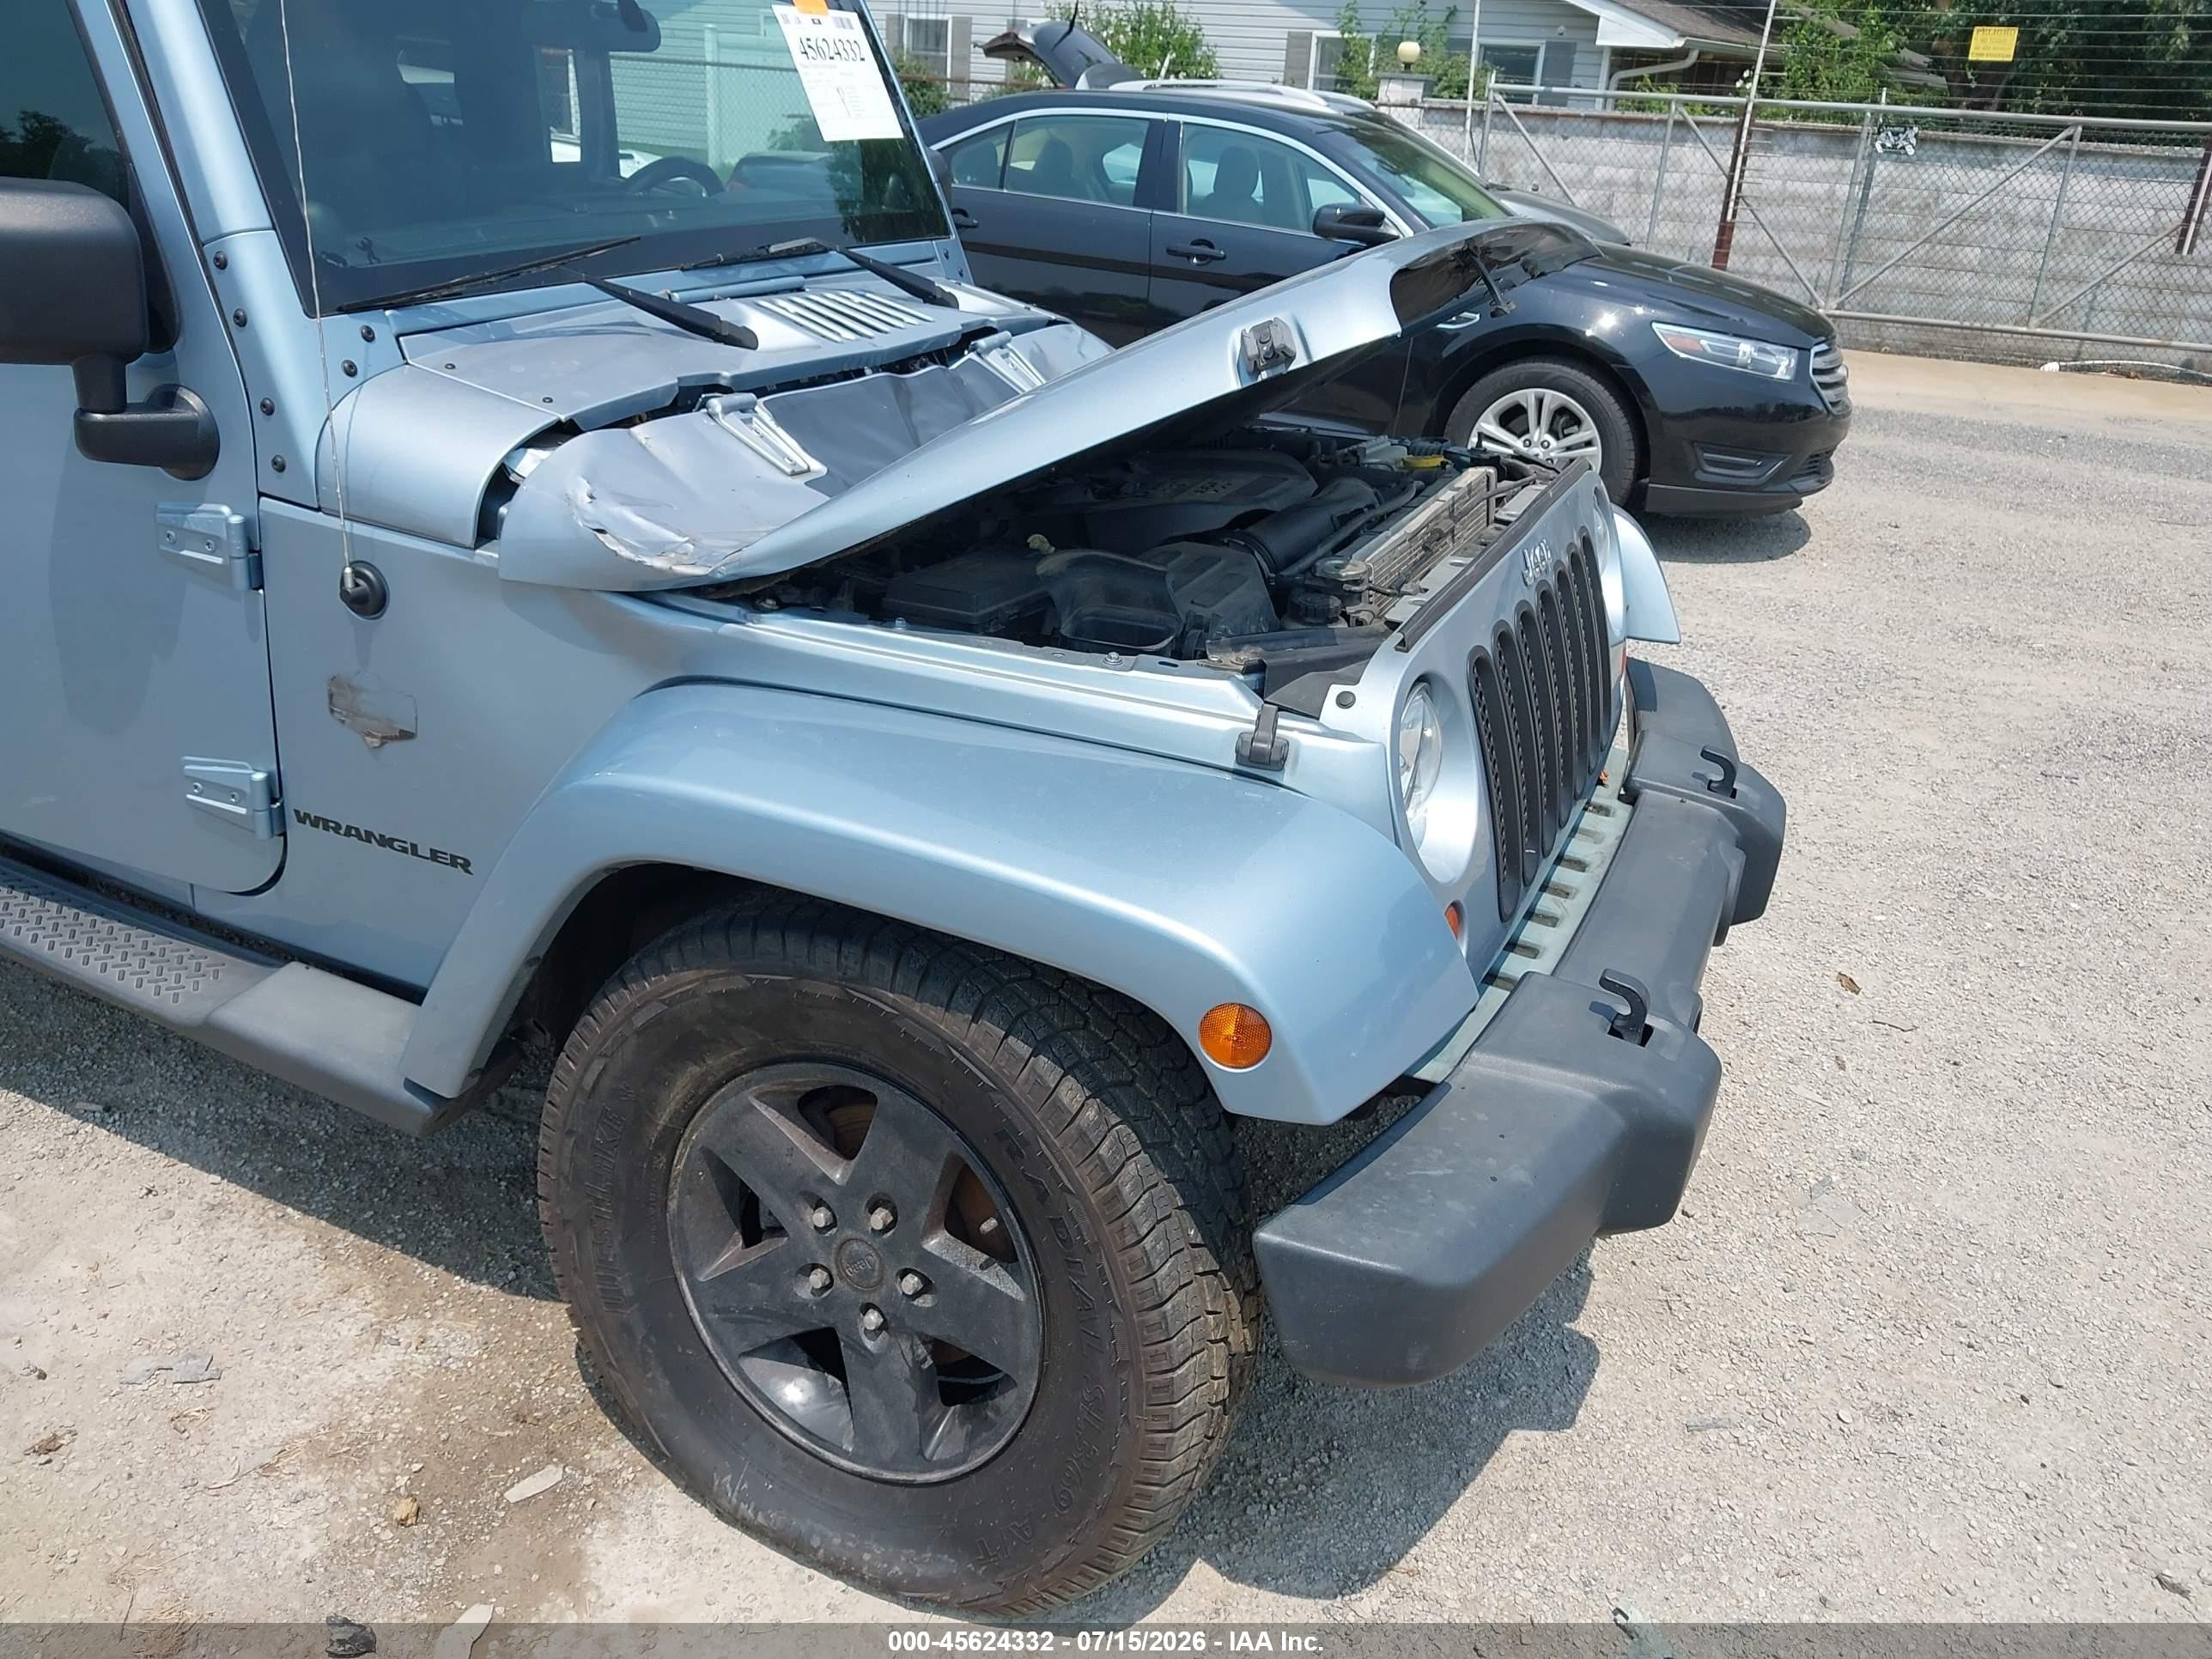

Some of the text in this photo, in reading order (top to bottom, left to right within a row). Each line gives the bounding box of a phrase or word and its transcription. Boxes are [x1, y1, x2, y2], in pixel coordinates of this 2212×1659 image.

[799, 37, 865, 61] 45624332
[1522, 538, 1552, 586] Jeep
[294, 809, 473, 875] WRANGLER
